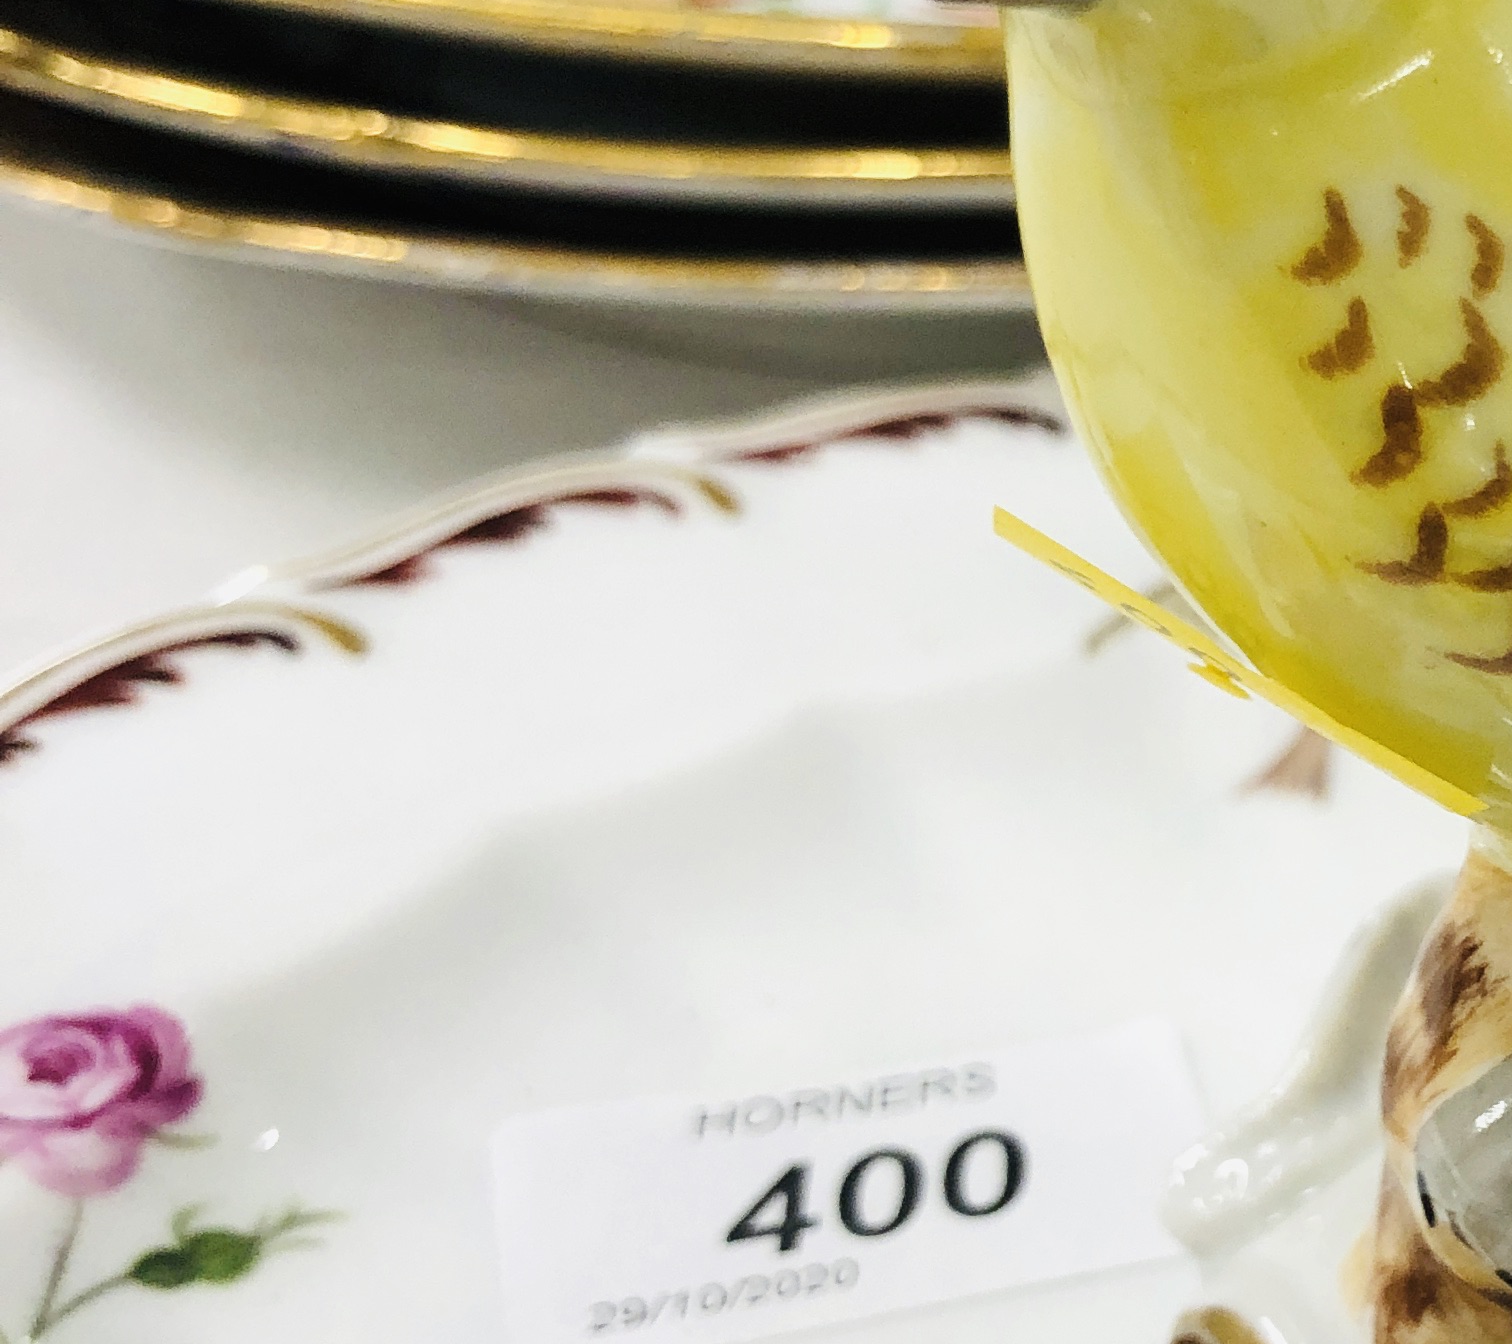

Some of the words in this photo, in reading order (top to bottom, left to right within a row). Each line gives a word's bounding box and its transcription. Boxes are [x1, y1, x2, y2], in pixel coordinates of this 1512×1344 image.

[694, 1060, 998, 1138] HORNERS
[724, 1128, 1027, 1255] 400
[587, 1257, 861, 1336] 29/10/2020
